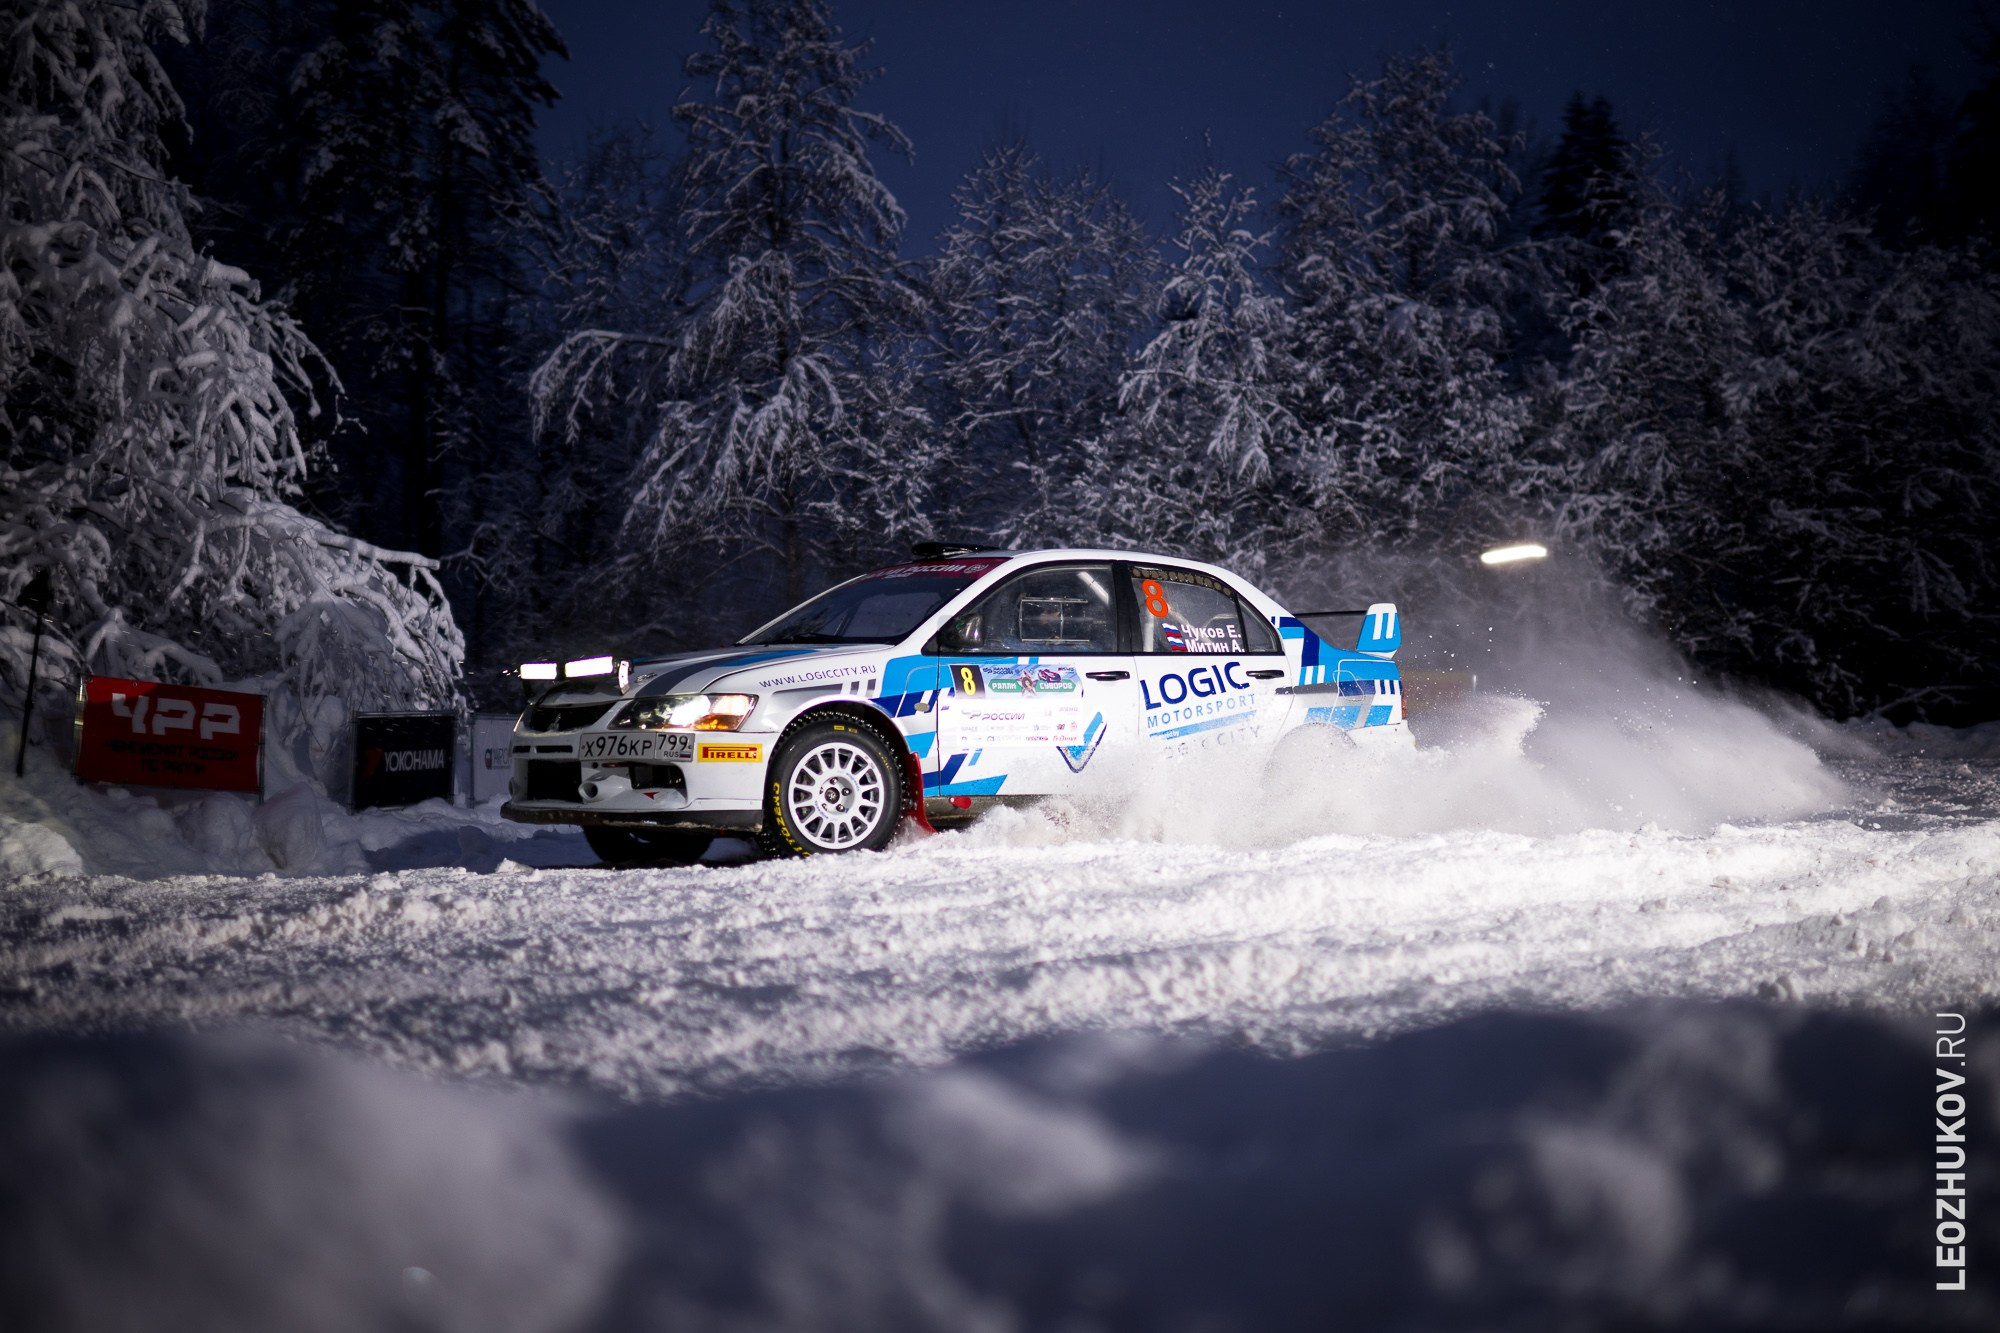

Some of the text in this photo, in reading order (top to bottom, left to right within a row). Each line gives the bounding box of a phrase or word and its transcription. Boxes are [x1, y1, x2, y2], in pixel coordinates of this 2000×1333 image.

[1141, 579, 1169, 618] 8
[1181, 624, 1241, 638] Чуков Е.
[1186, 640, 1229, 653] Митин
[759, 665, 877, 689] WWW.LOGICCITY.RU
[960, 666, 976, 696] 8
[992, 682, 1073, 690] РАЛЛИ СУВОРОВ
[1140, 660, 1250, 711] LOGIC
[111, 692, 241, 741] ЧРР
[982, 712, 1026, 721] РОССИИ
[1147, 693, 1256, 729] MOTORSPORT
[658, 734, 689, 752] 799
[702, 746, 758, 759] PIRELLI
[384, 749, 445, 773] YOKOHAMA
